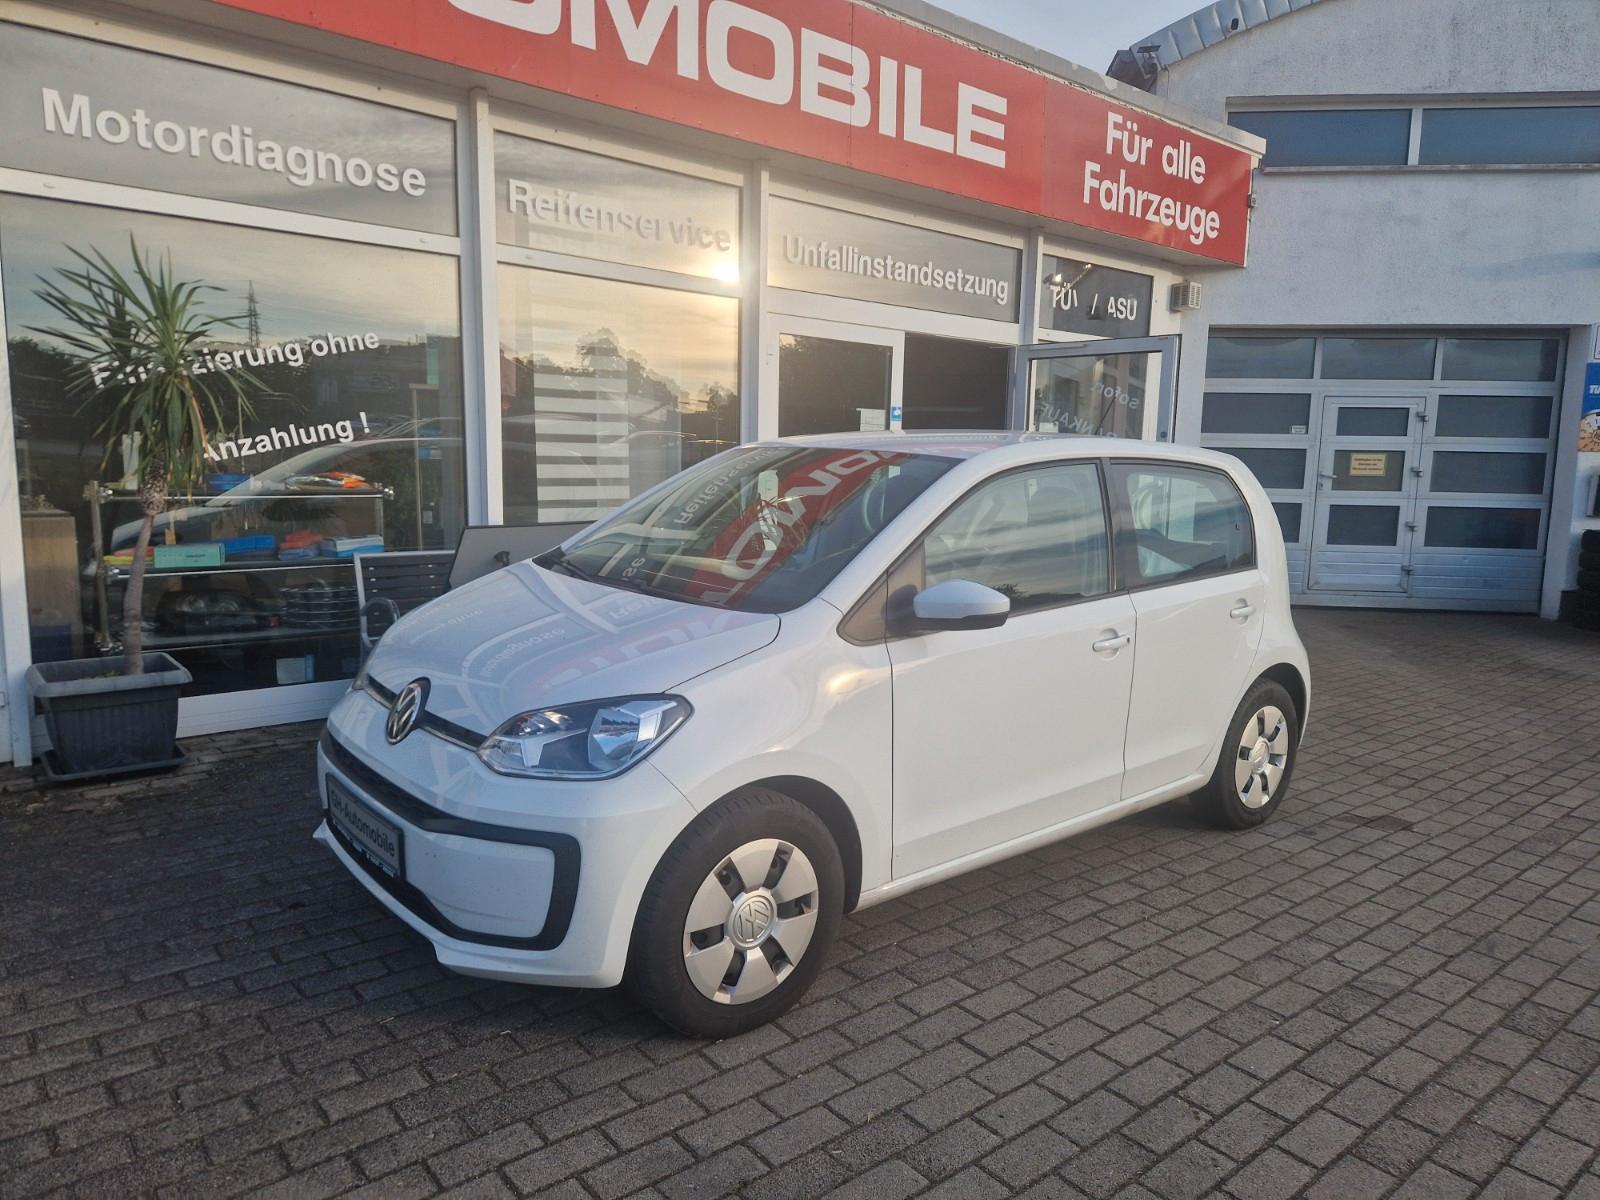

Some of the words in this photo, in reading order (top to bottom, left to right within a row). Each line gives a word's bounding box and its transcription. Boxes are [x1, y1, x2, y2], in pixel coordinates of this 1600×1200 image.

[41, 87, 427, 197] Motordiagnose
[1106, 111, 1153, 165] Für
[1162, 140, 1206, 184] alle
[1083, 159, 1221, 245] Fahrzeuge
[784, 234, 1010, 305] Unfallinstandsetzung
[1107, 296, 1138, 320] ASU
[311, 331, 380, 358] ohne
